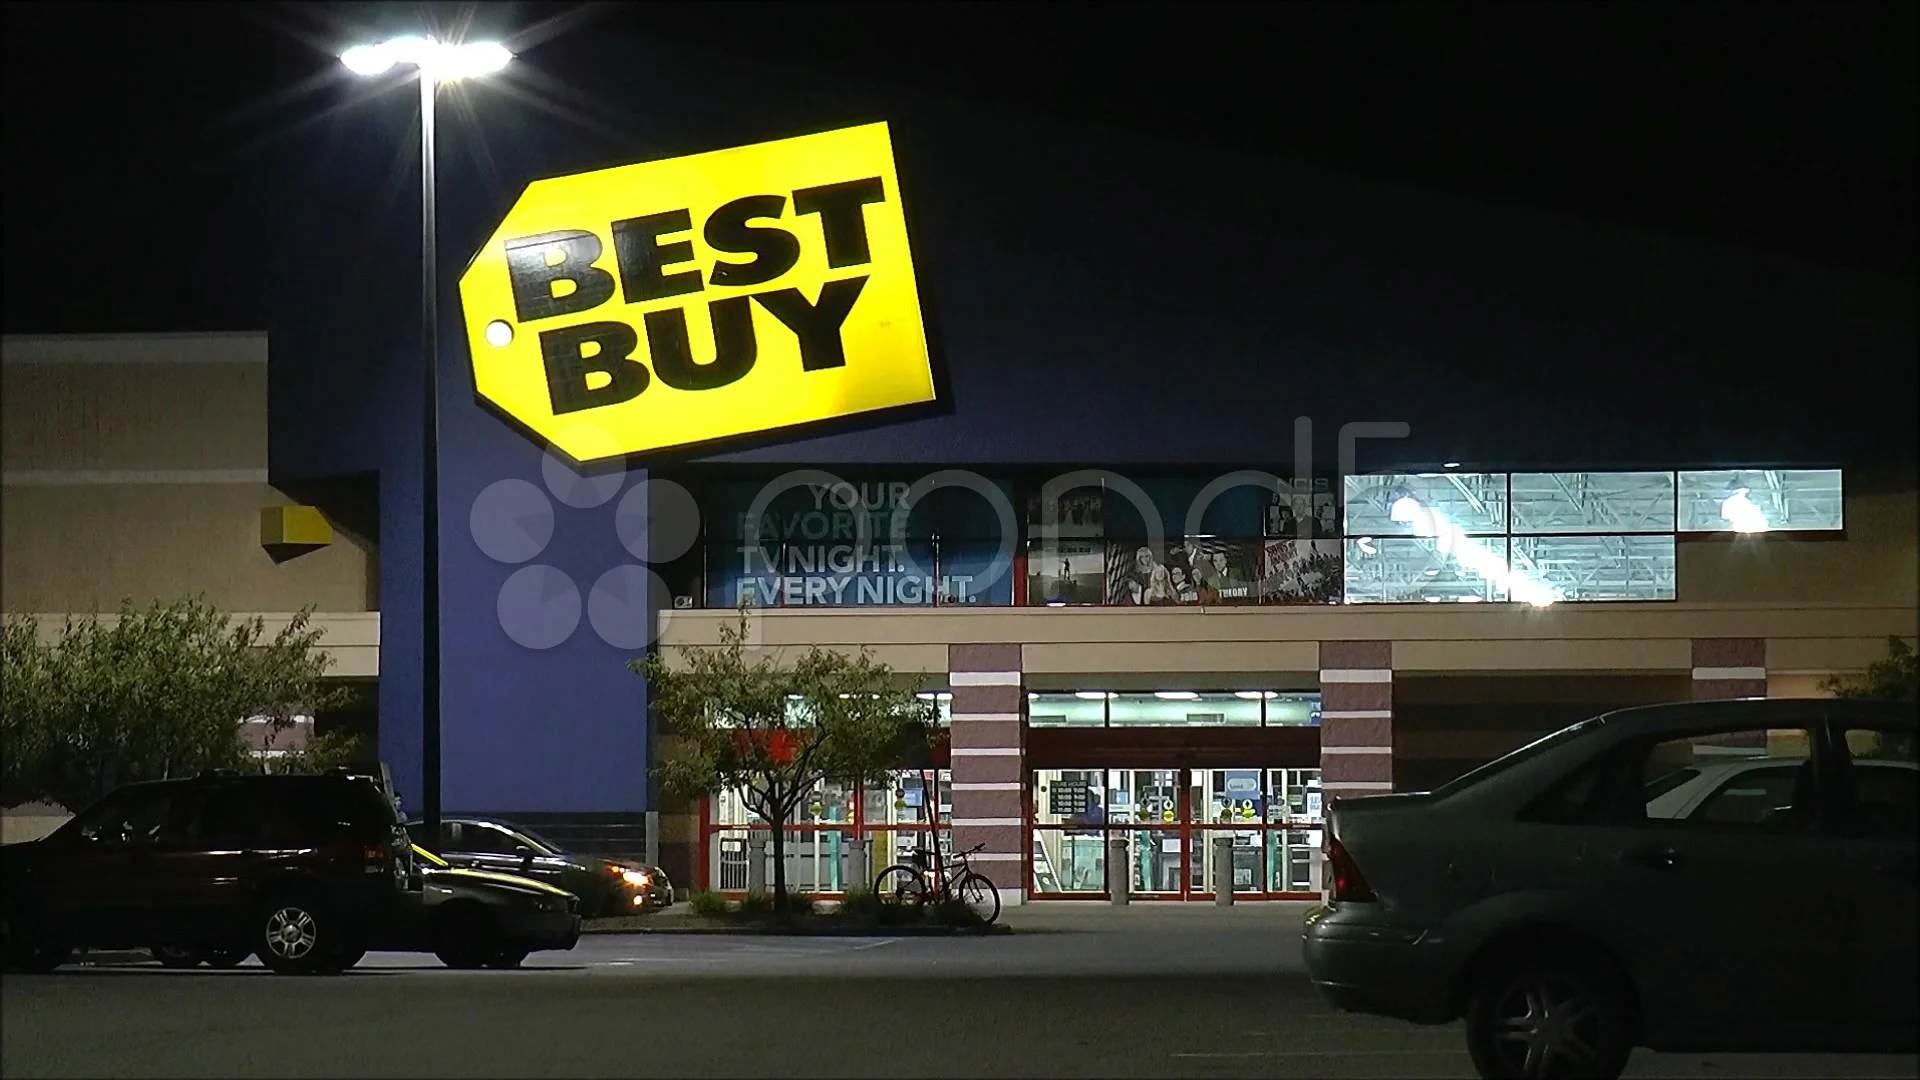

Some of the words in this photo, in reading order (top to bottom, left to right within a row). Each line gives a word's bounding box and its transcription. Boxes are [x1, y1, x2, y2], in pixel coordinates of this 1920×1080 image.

[504, 176, 886, 323] BEST
[538, 274, 871, 416] BUY
[808, 482, 911, 510] YOUR
[736, 512, 910, 540] FAVORITE
[736, 545, 786, 574] TV
[789, 545, 905, 574] NIGHT.
[736, 576, 851, 605] EVERY
[857, 576, 977, 605] NIGHT.
[1218, 587, 1248, 598] THEORY
